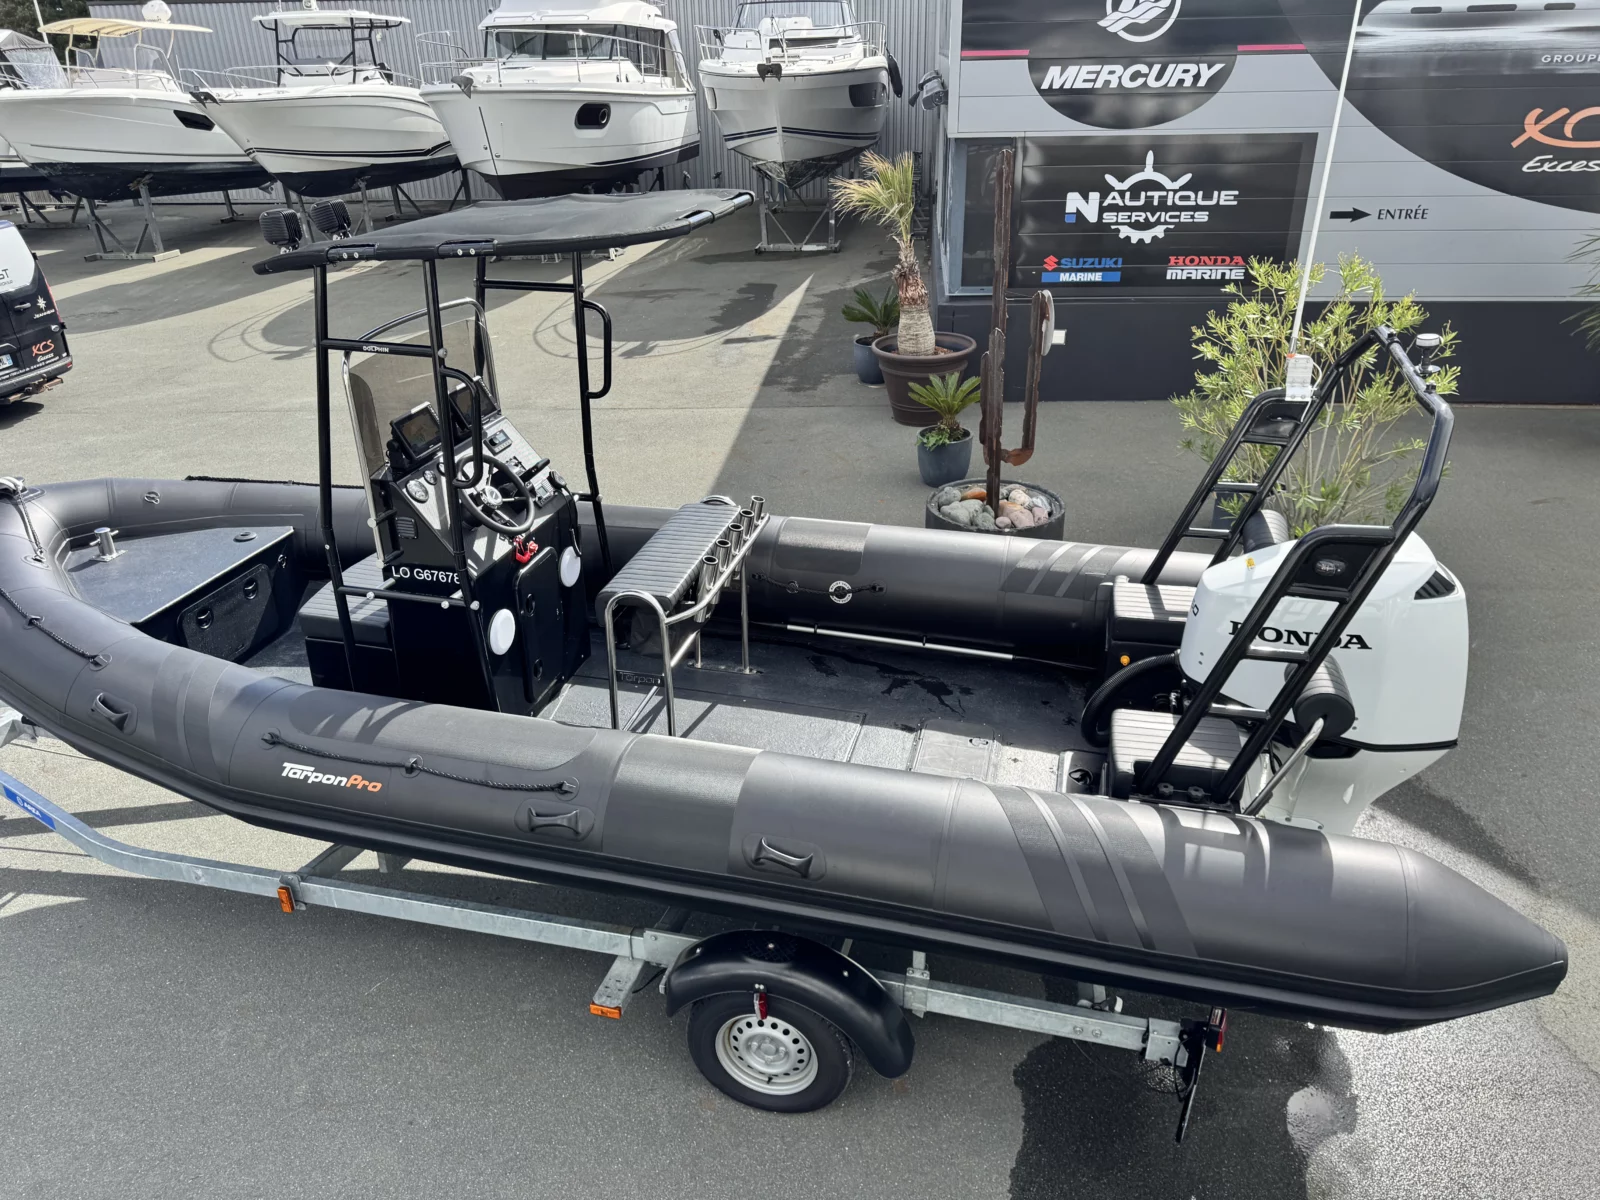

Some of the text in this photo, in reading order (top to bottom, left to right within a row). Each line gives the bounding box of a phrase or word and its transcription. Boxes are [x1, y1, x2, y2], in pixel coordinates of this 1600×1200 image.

[1040, 63, 1226, 90] MERCURY
[1065, 190, 1240, 223] NAUTIQUE
[1377, 205, 1430, 220] ENTRÉE
[1102, 211, 1210, 223] SERVICES
[1060, 257, 1123, 269] SUZUKI
[1168, 255, 1246, 266] HONDA
[1059, 272, 1103, 282] MARINE
[1166, 269, 1245, 280] MARINE
[362, 345, 390, 353] DOLPHIN
[391, 565, 411, 579] LO
[1228, 620, 1373, 650] ONA
